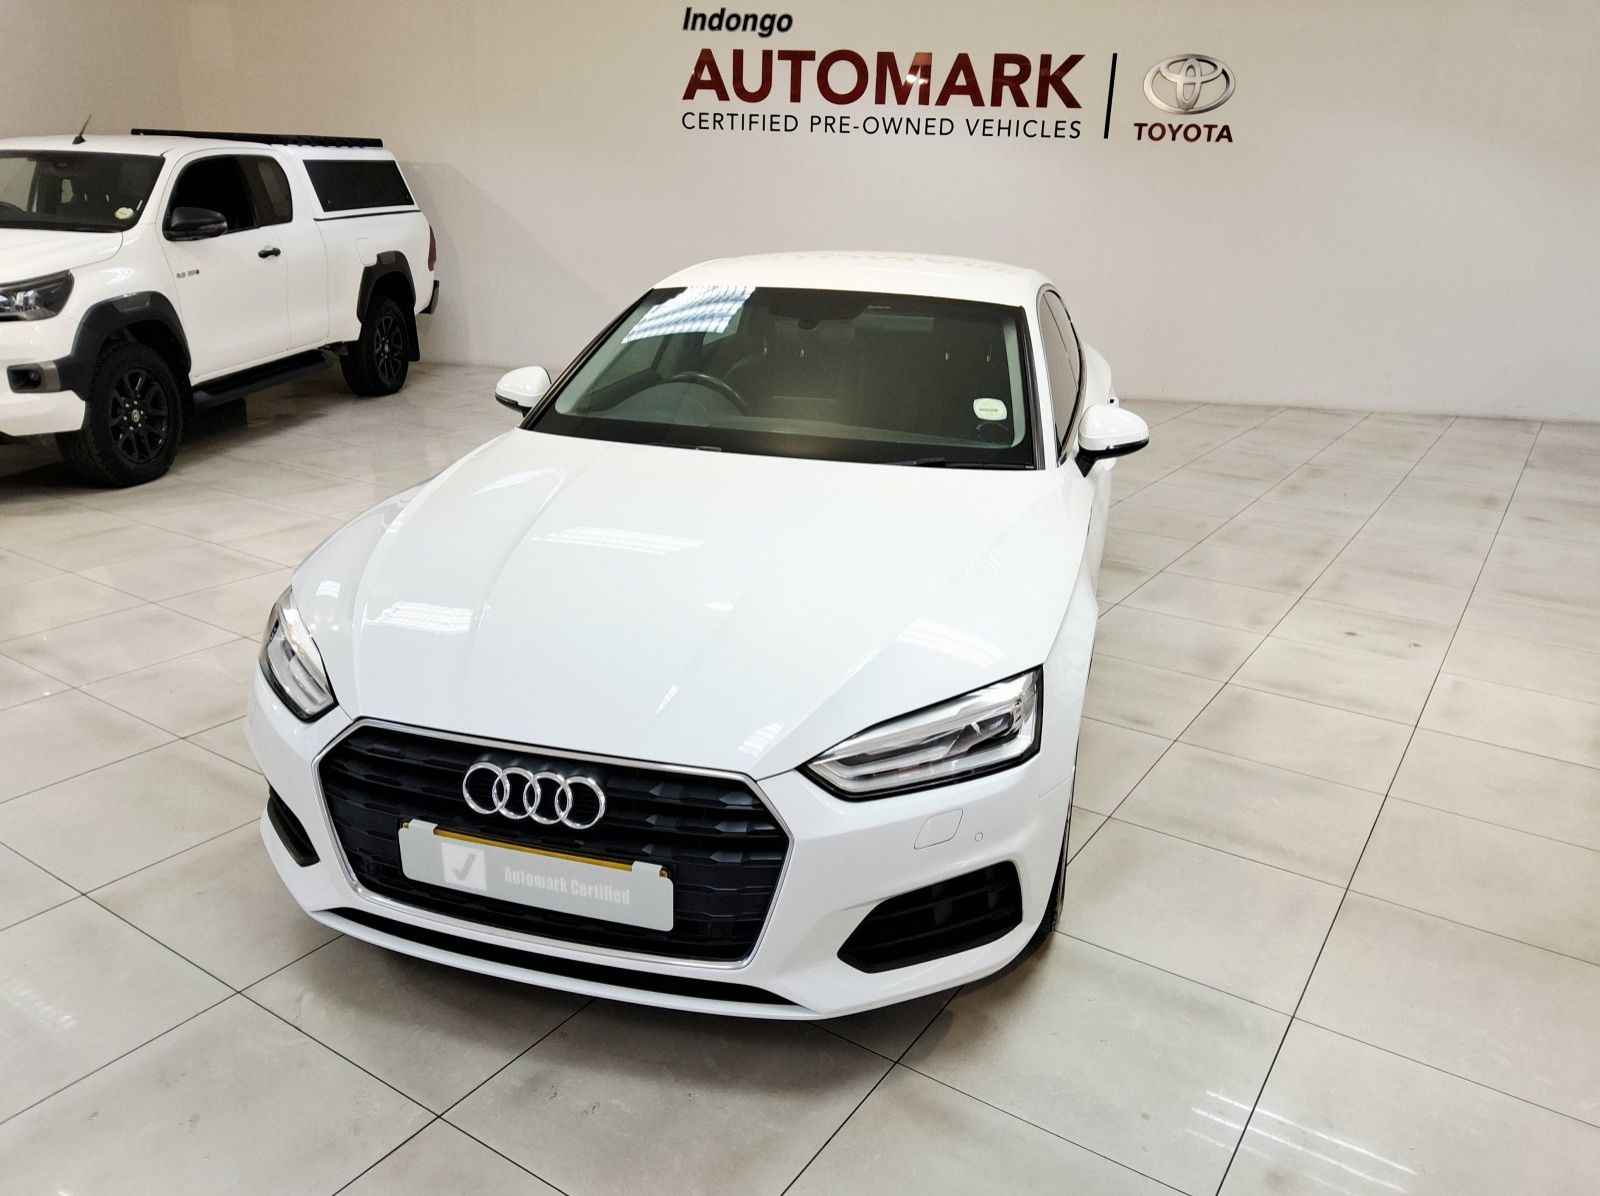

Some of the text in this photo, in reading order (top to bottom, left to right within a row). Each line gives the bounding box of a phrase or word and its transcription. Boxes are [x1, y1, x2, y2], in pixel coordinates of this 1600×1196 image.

[683, 7, 793, 38] Indongo
[682, 48, 1085, 108] AUTOMARK
[681, 112, 1081, 139] CERTIFIED PRE-OWNED VEHICLES
[1134, 122, 1233, 143] TOYOTA
[503, 866, 631, 906] Automark Certified
